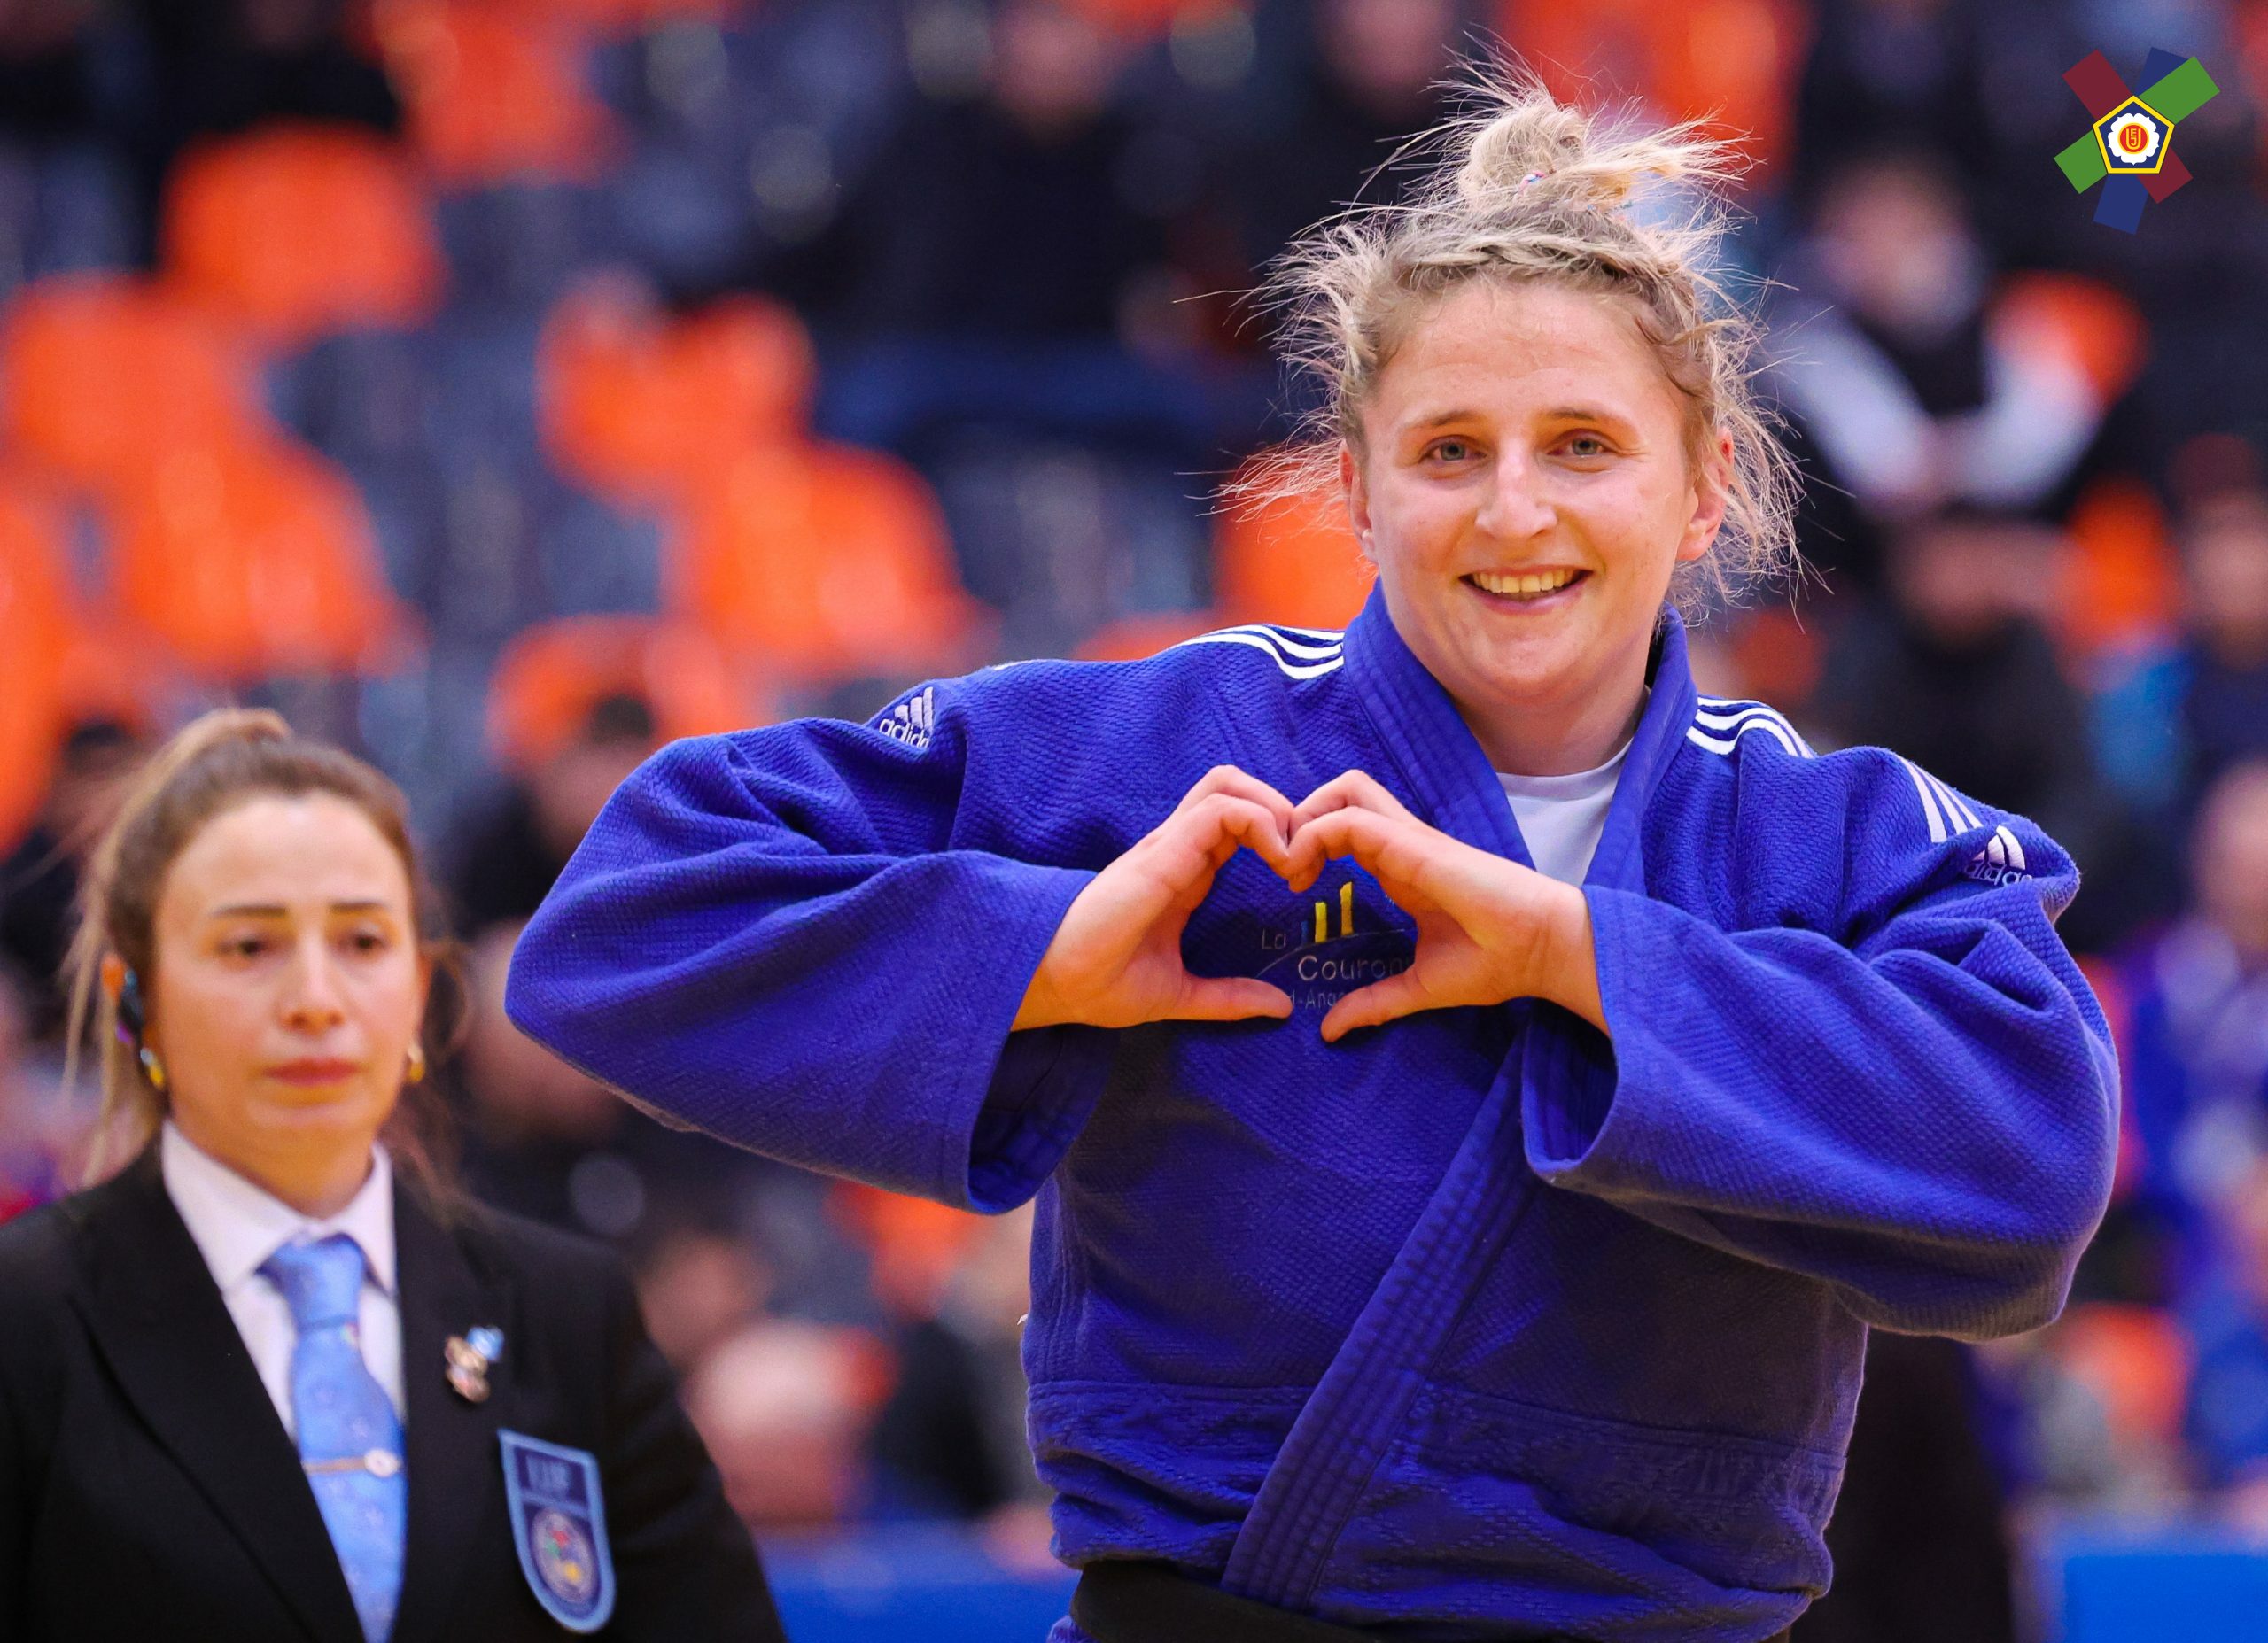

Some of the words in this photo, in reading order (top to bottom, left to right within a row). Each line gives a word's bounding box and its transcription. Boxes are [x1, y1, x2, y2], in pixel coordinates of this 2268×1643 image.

[879, 718, 930, 748] adida
[1262, 927, 1286, 950] La
[1298, 955, 1410, 982] Couron
